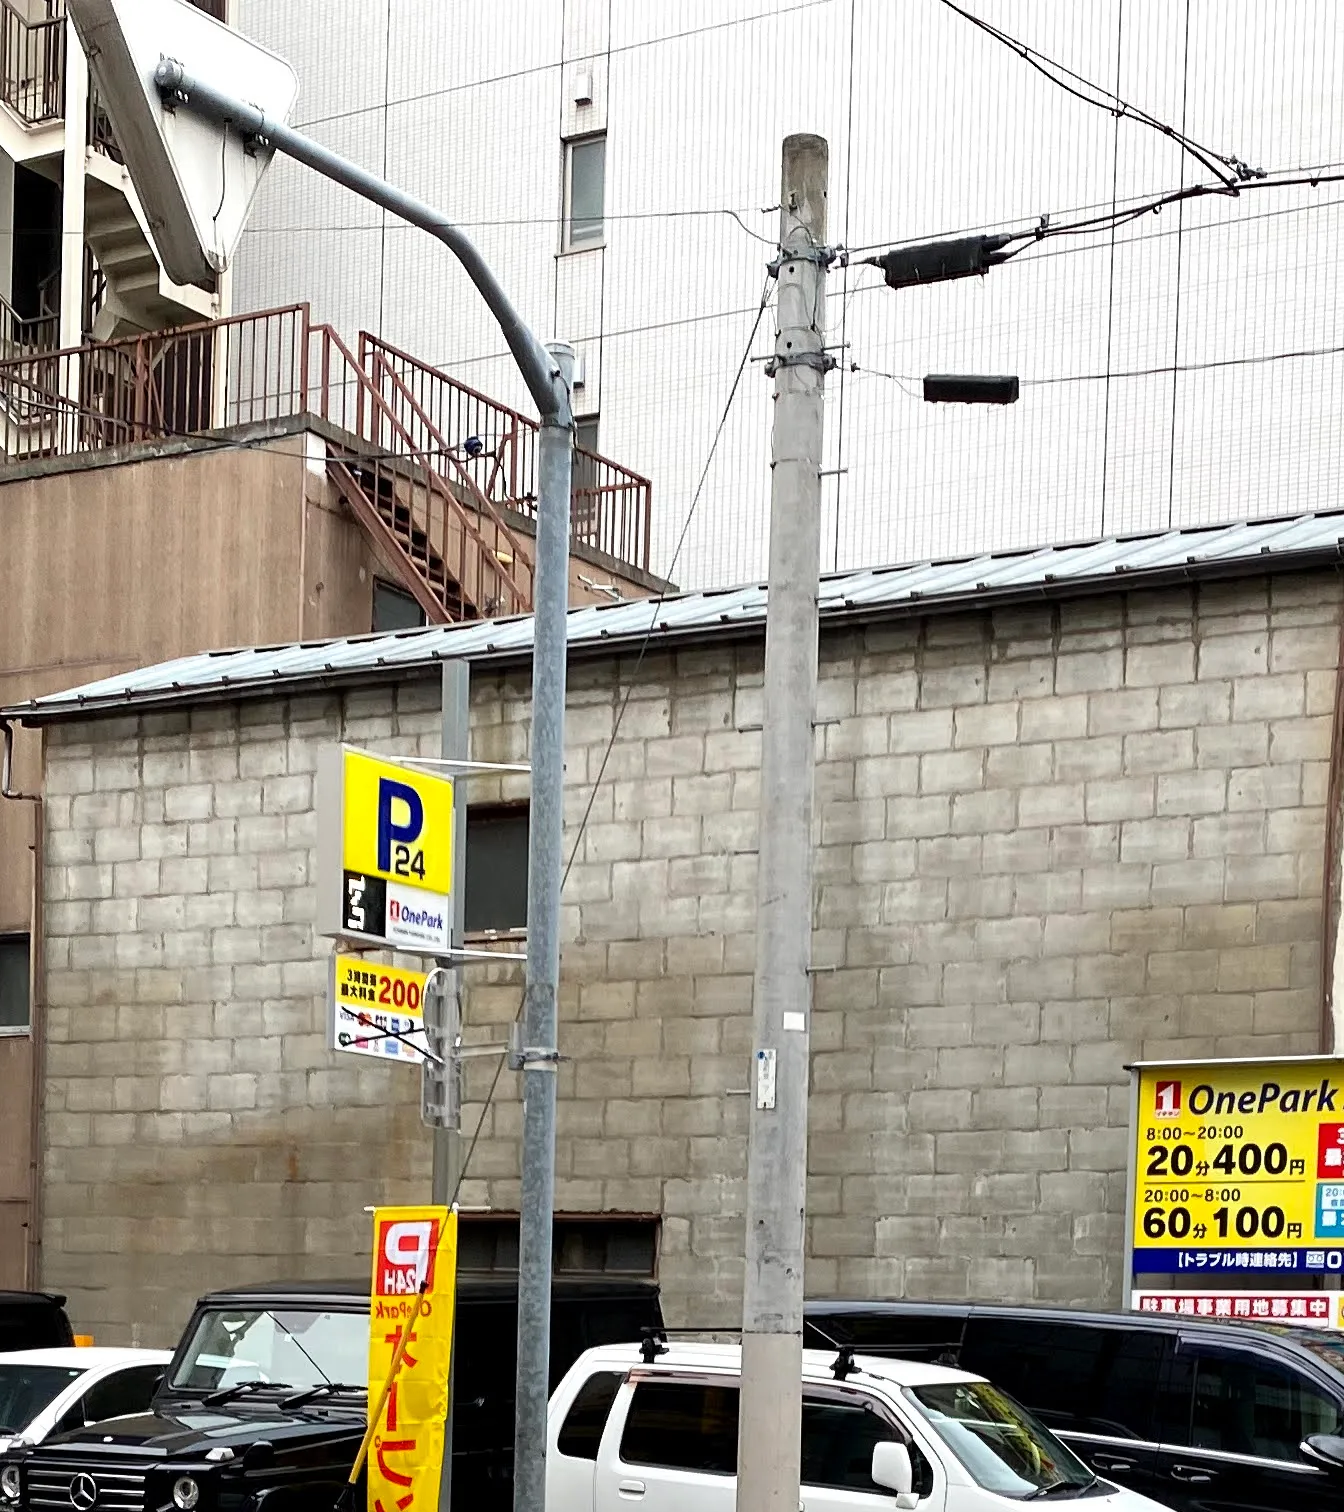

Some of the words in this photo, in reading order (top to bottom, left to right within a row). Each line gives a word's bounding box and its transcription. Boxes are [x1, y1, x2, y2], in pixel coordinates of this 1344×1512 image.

[378, 776, 423, 873] P
[395, 846, 426, 880] 24
[401, 905, 443, 930] OnePark
[379, 976, 424, 1010] 200
[1189, 1079, 1339, 1115] OnePark
